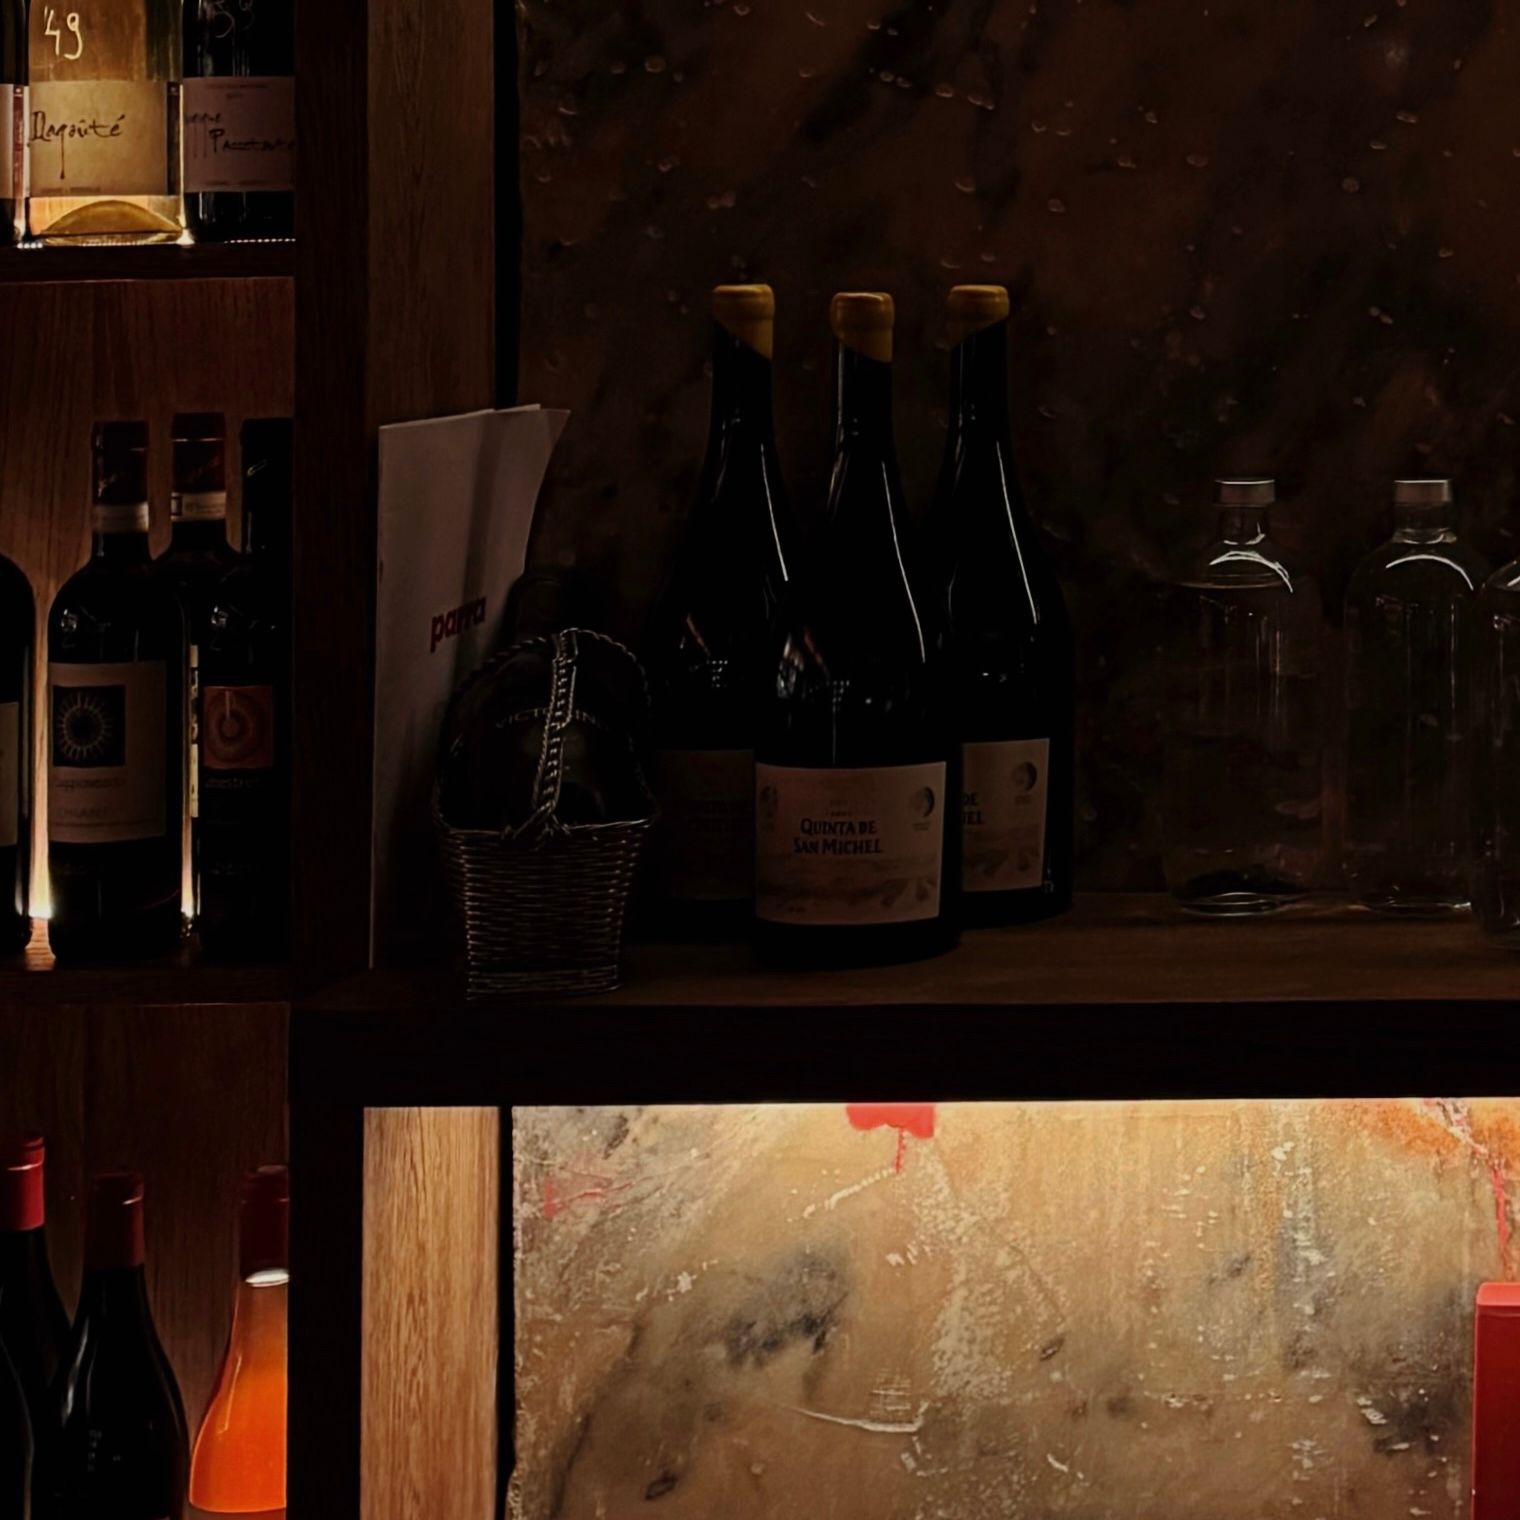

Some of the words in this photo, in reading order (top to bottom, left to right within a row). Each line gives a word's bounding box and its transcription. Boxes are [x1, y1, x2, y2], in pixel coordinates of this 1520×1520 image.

[44, 5, 83, 60] 49
[430, 596, 487, 654] parra
[800, 818, 856, 837] QUINTA
[858, 820, 878, 835] DE
[793, 837, 819, 855] SAN
[821, 838, 884, 856] MICHEL
